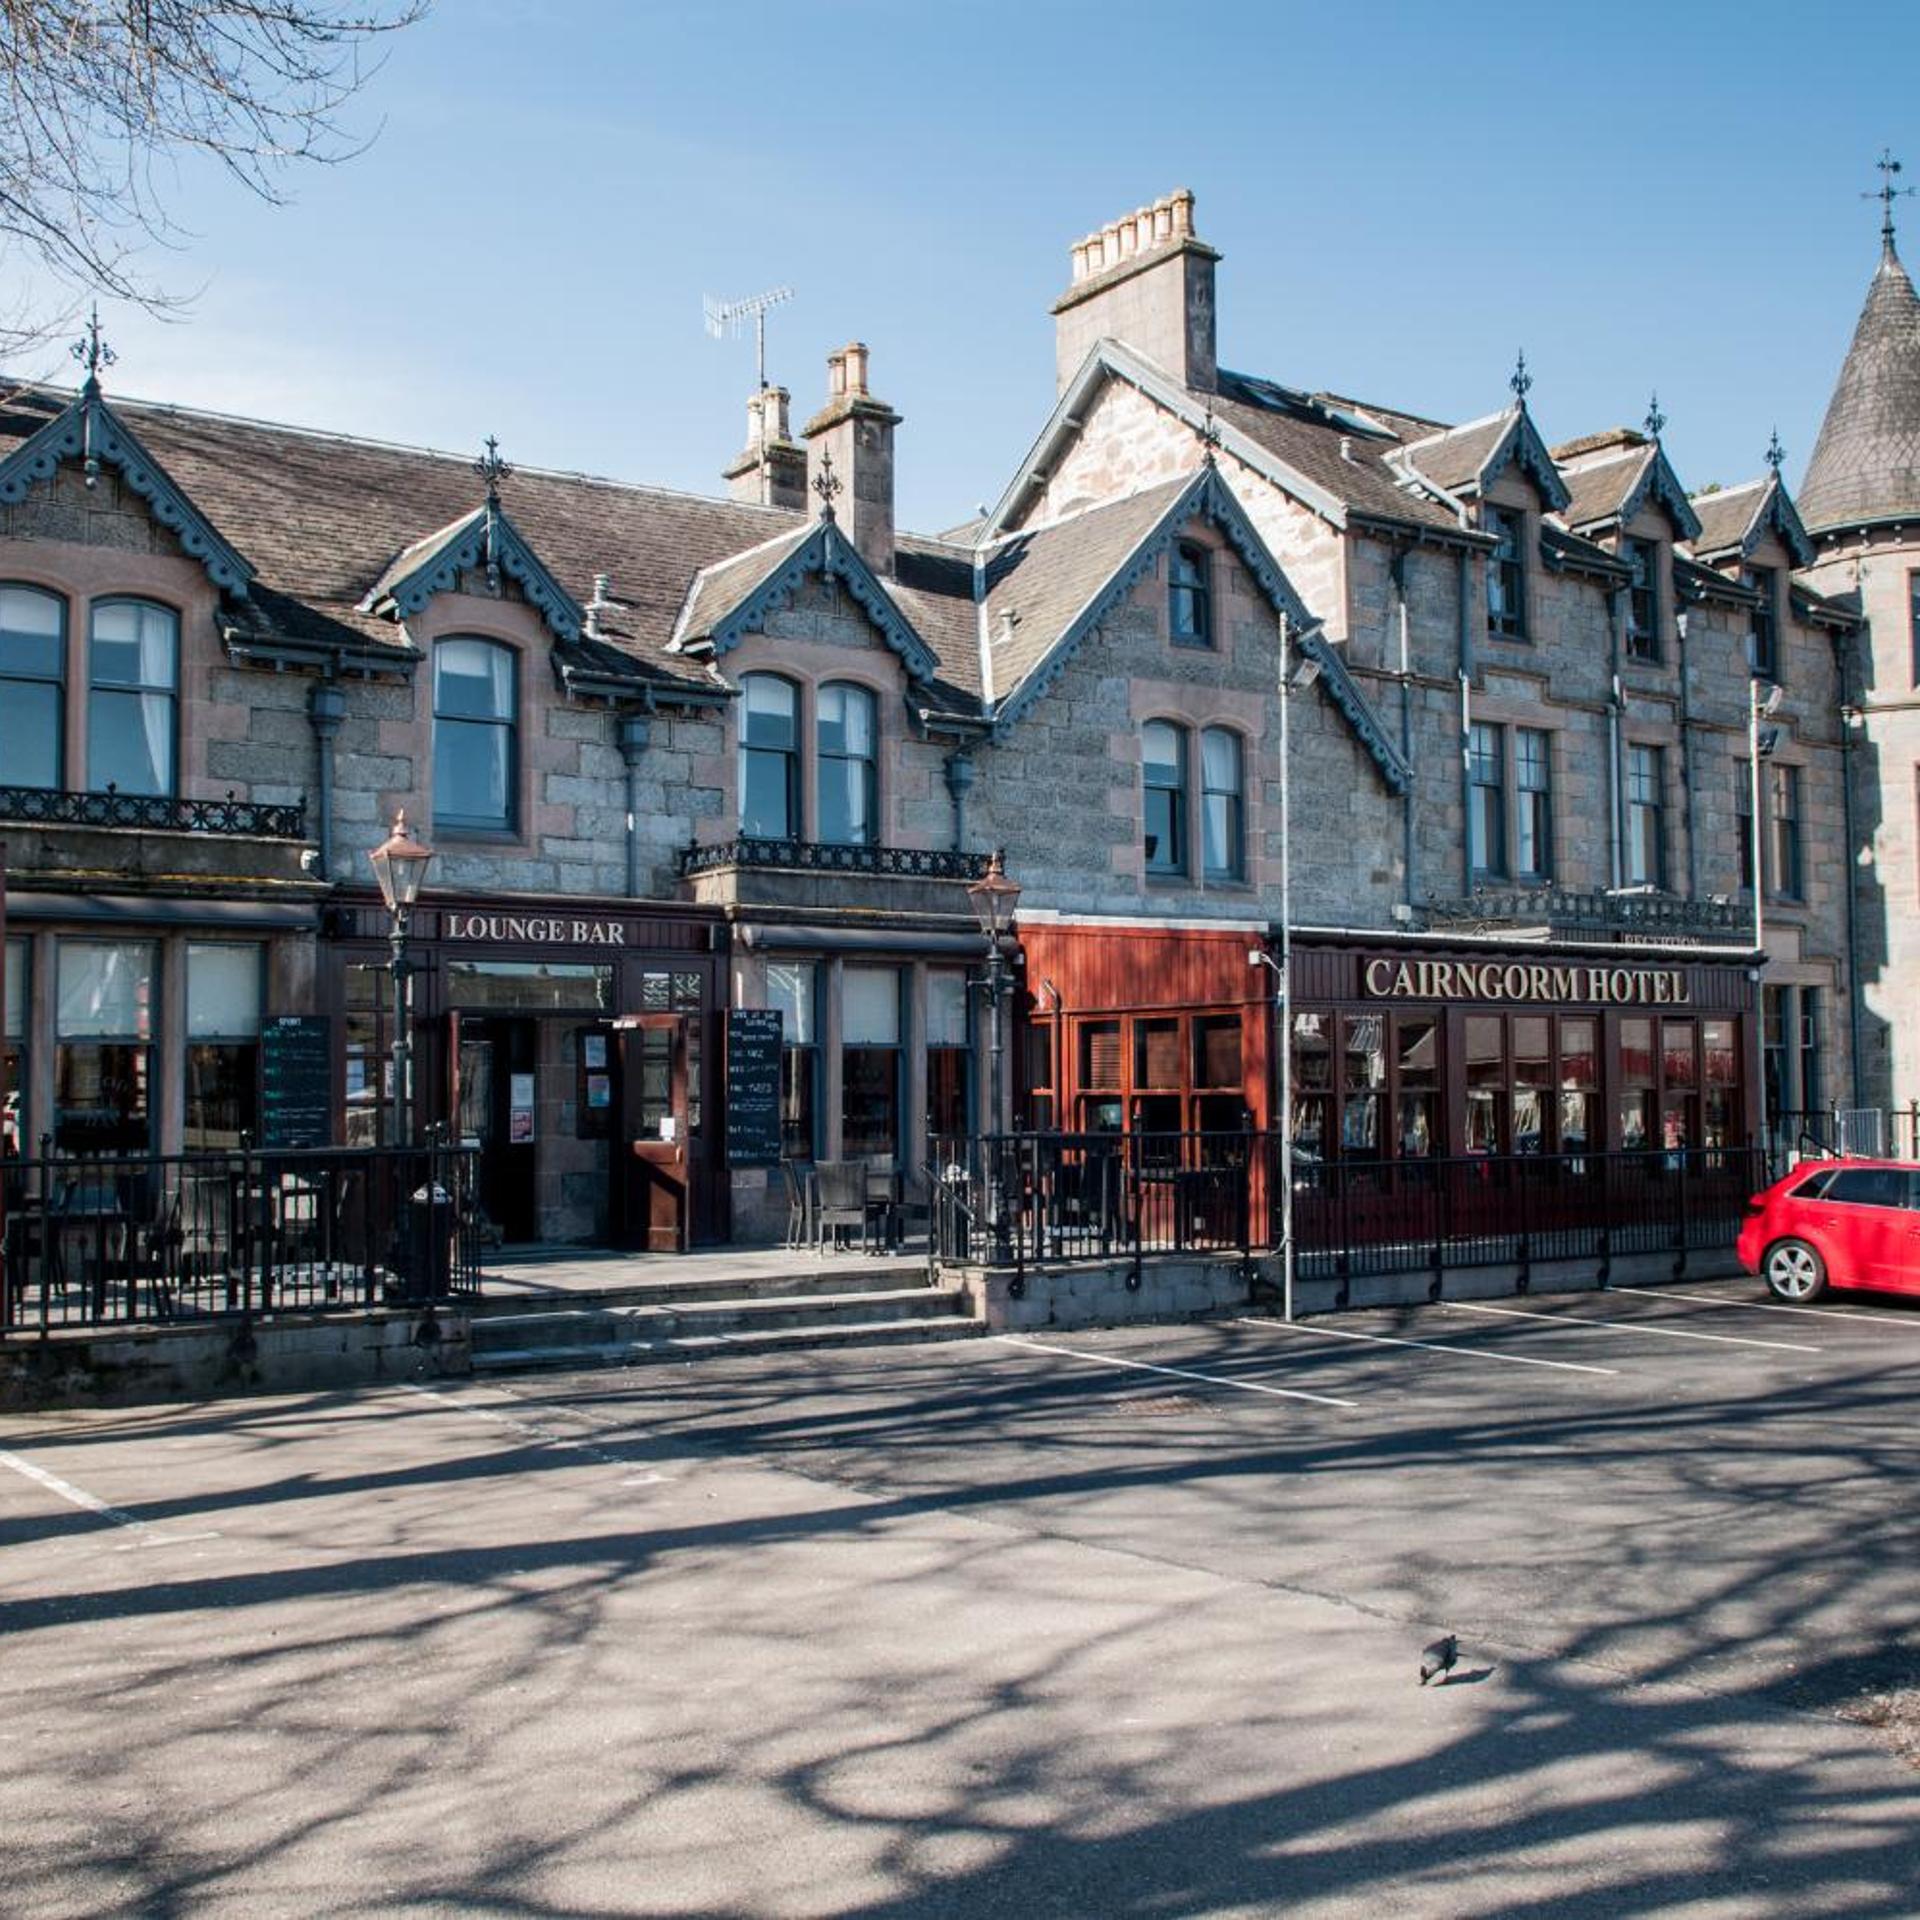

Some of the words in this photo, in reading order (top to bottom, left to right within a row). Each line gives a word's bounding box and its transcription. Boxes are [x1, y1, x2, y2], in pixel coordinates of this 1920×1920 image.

[449, 915, 565, 942] LOUNGE
[572, 920, 625, 944] BAR
[1366, 959, 1578, 1001] CAIRNGORM
[1588, 968, 1690, 1003] HOTEL
